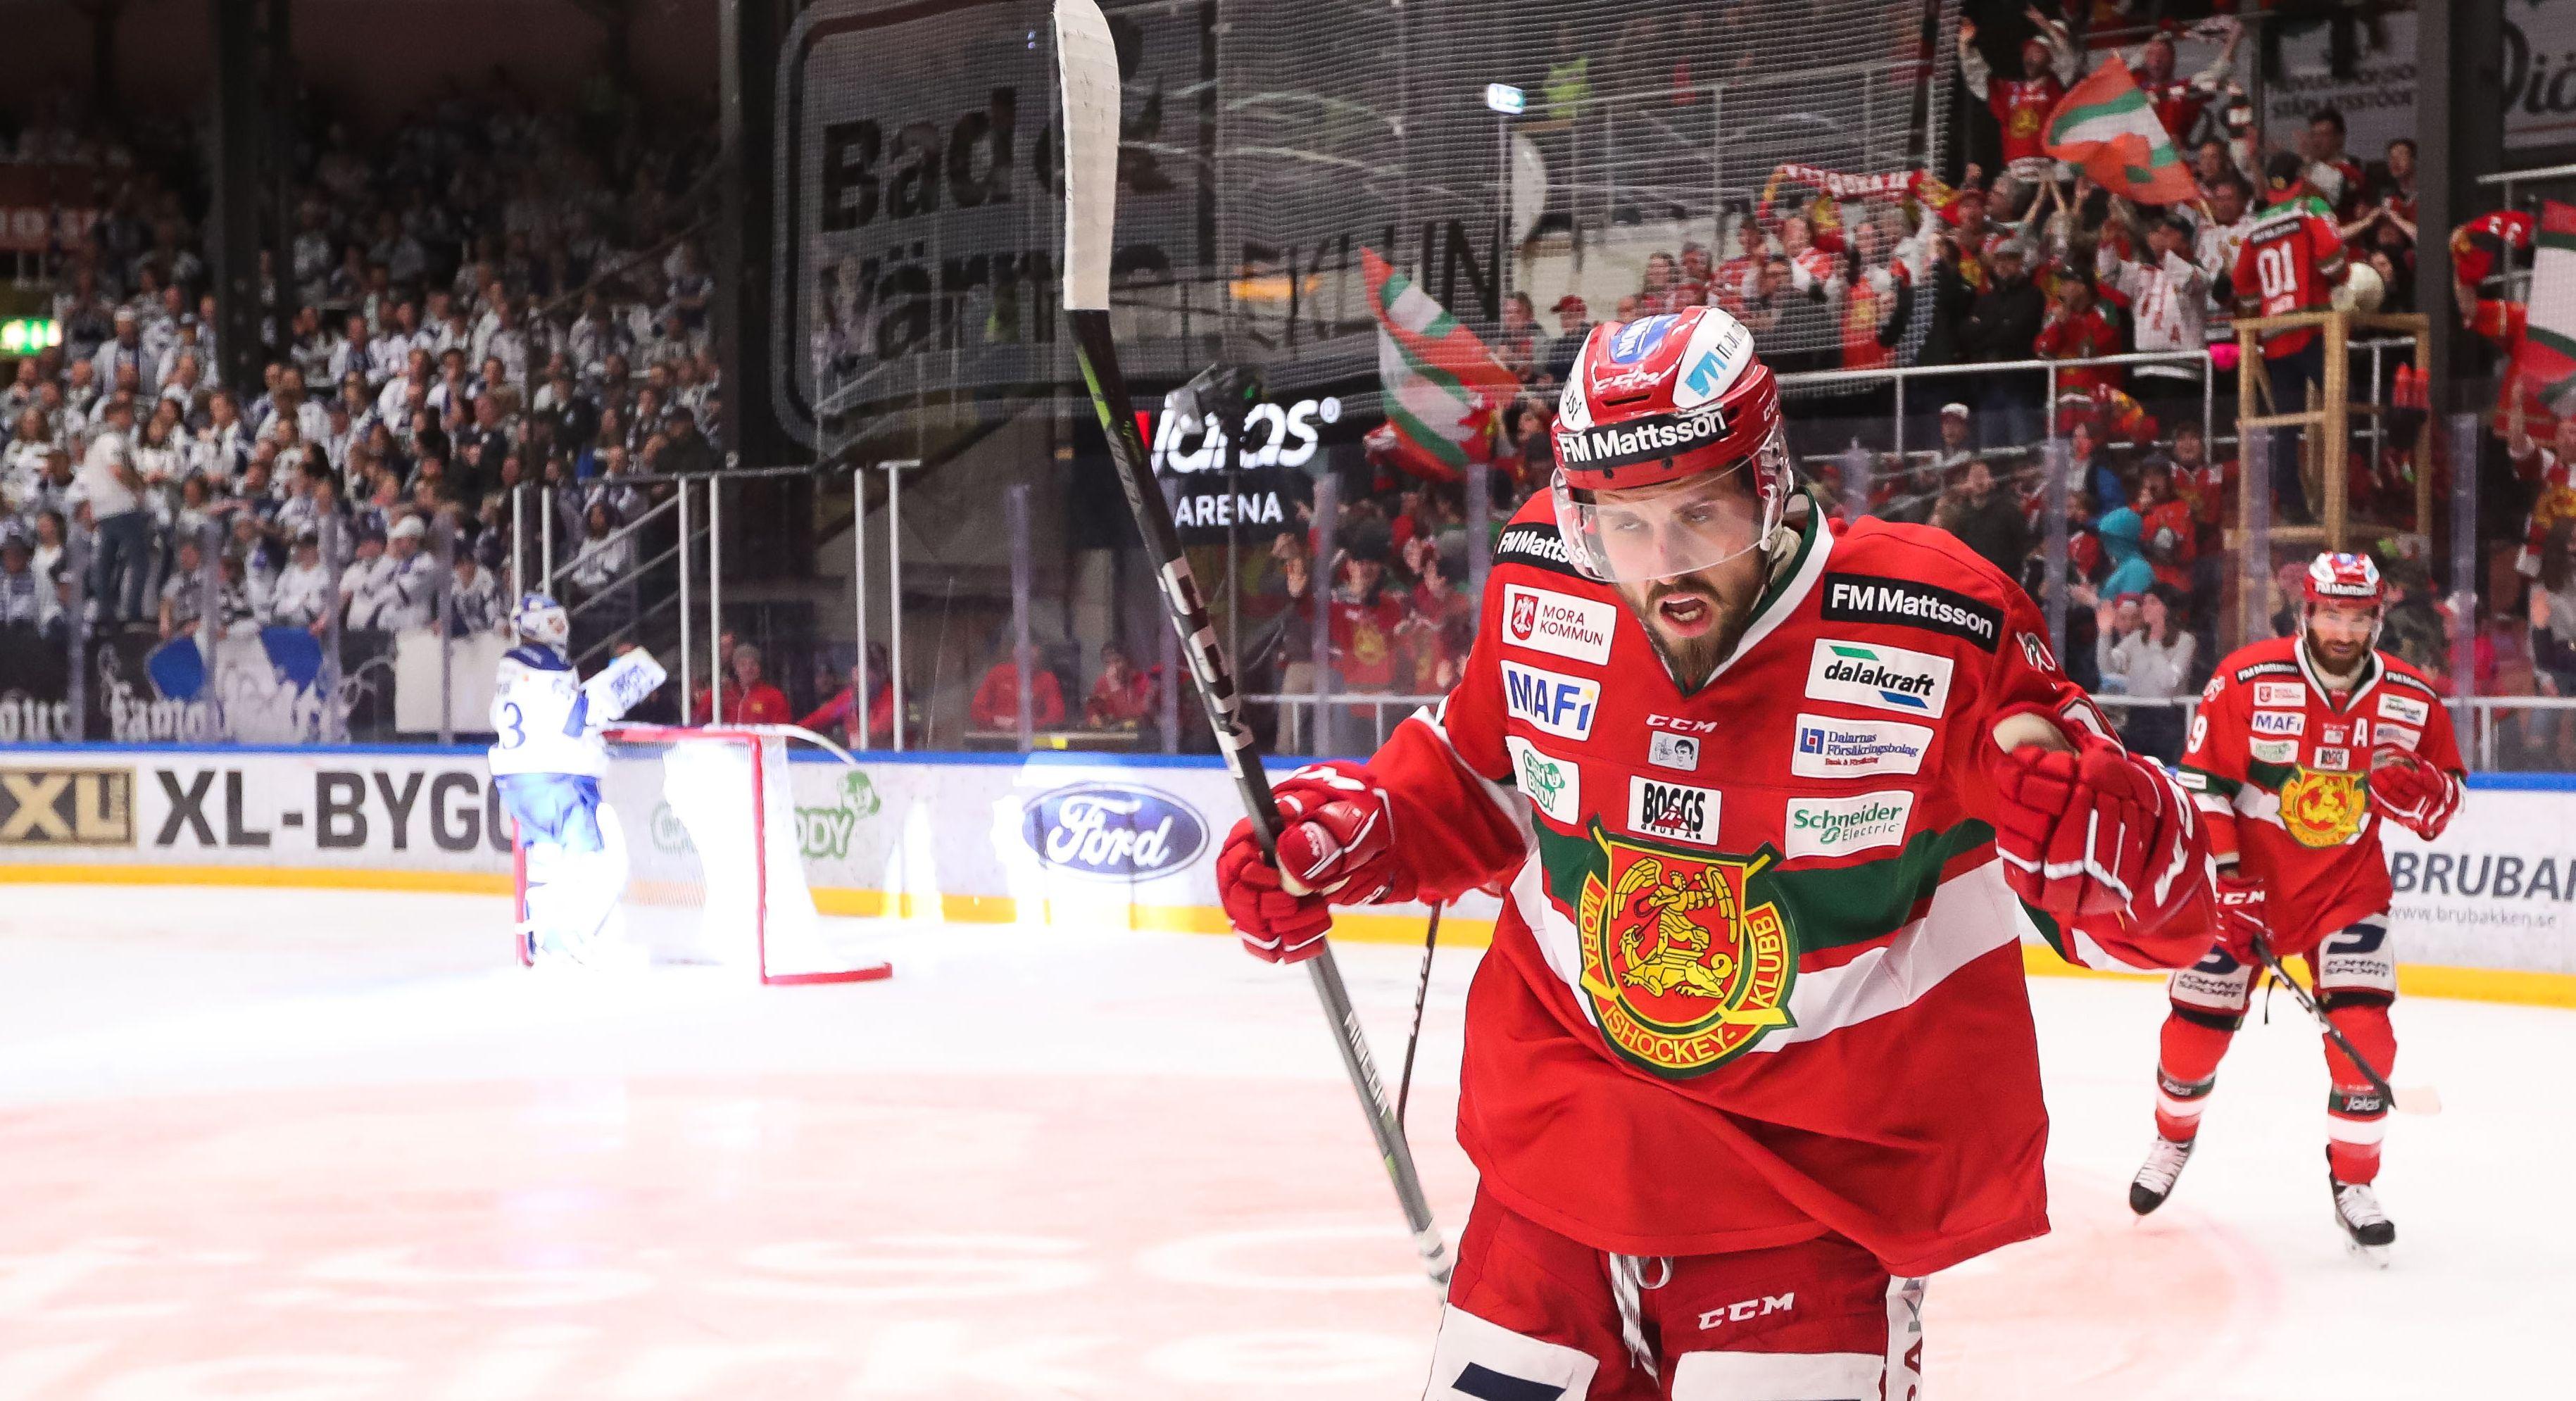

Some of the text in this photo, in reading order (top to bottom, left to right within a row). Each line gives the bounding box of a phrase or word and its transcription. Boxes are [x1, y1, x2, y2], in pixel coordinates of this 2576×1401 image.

[823, 88, 1017, 232] Bad
[2257, 241, 2297, 298] 01
[1560, 410, 1727, 463] FM Mattsson
[1174, 492, 1284, 528] ARENA
[1542, 604, 1584, 625] MORA
[1832, 584, 1992, 639] FM Mattsson
[1540, 622, 1604, 646] KOMMUN
[1825, 660, 1935, 696] dalakraft
[1645, 713, 1718, 733] CCM
[1828, 731, 1878, 744] Dalarnas
[2353, 717, 2368, 748] A
[1826, 743, 1920, 758] Försäkringsbolag
[0, 774, 126, 838] XL
[1642, 782, 1706, 833] BOGGS
[1794, 803, 1903, 829] Schneider
[1046, 795, 1172, 870] Ford
[1842, 823, 1895, 842] Electric
[1582, 888, 1602, 969] MORA
[1748, 915, 1782, 1008] KLUBB
[1603, 1005, 1739, 1063] ISHOCKEY-
[1697, 1292, 1795, 1329] CCM
